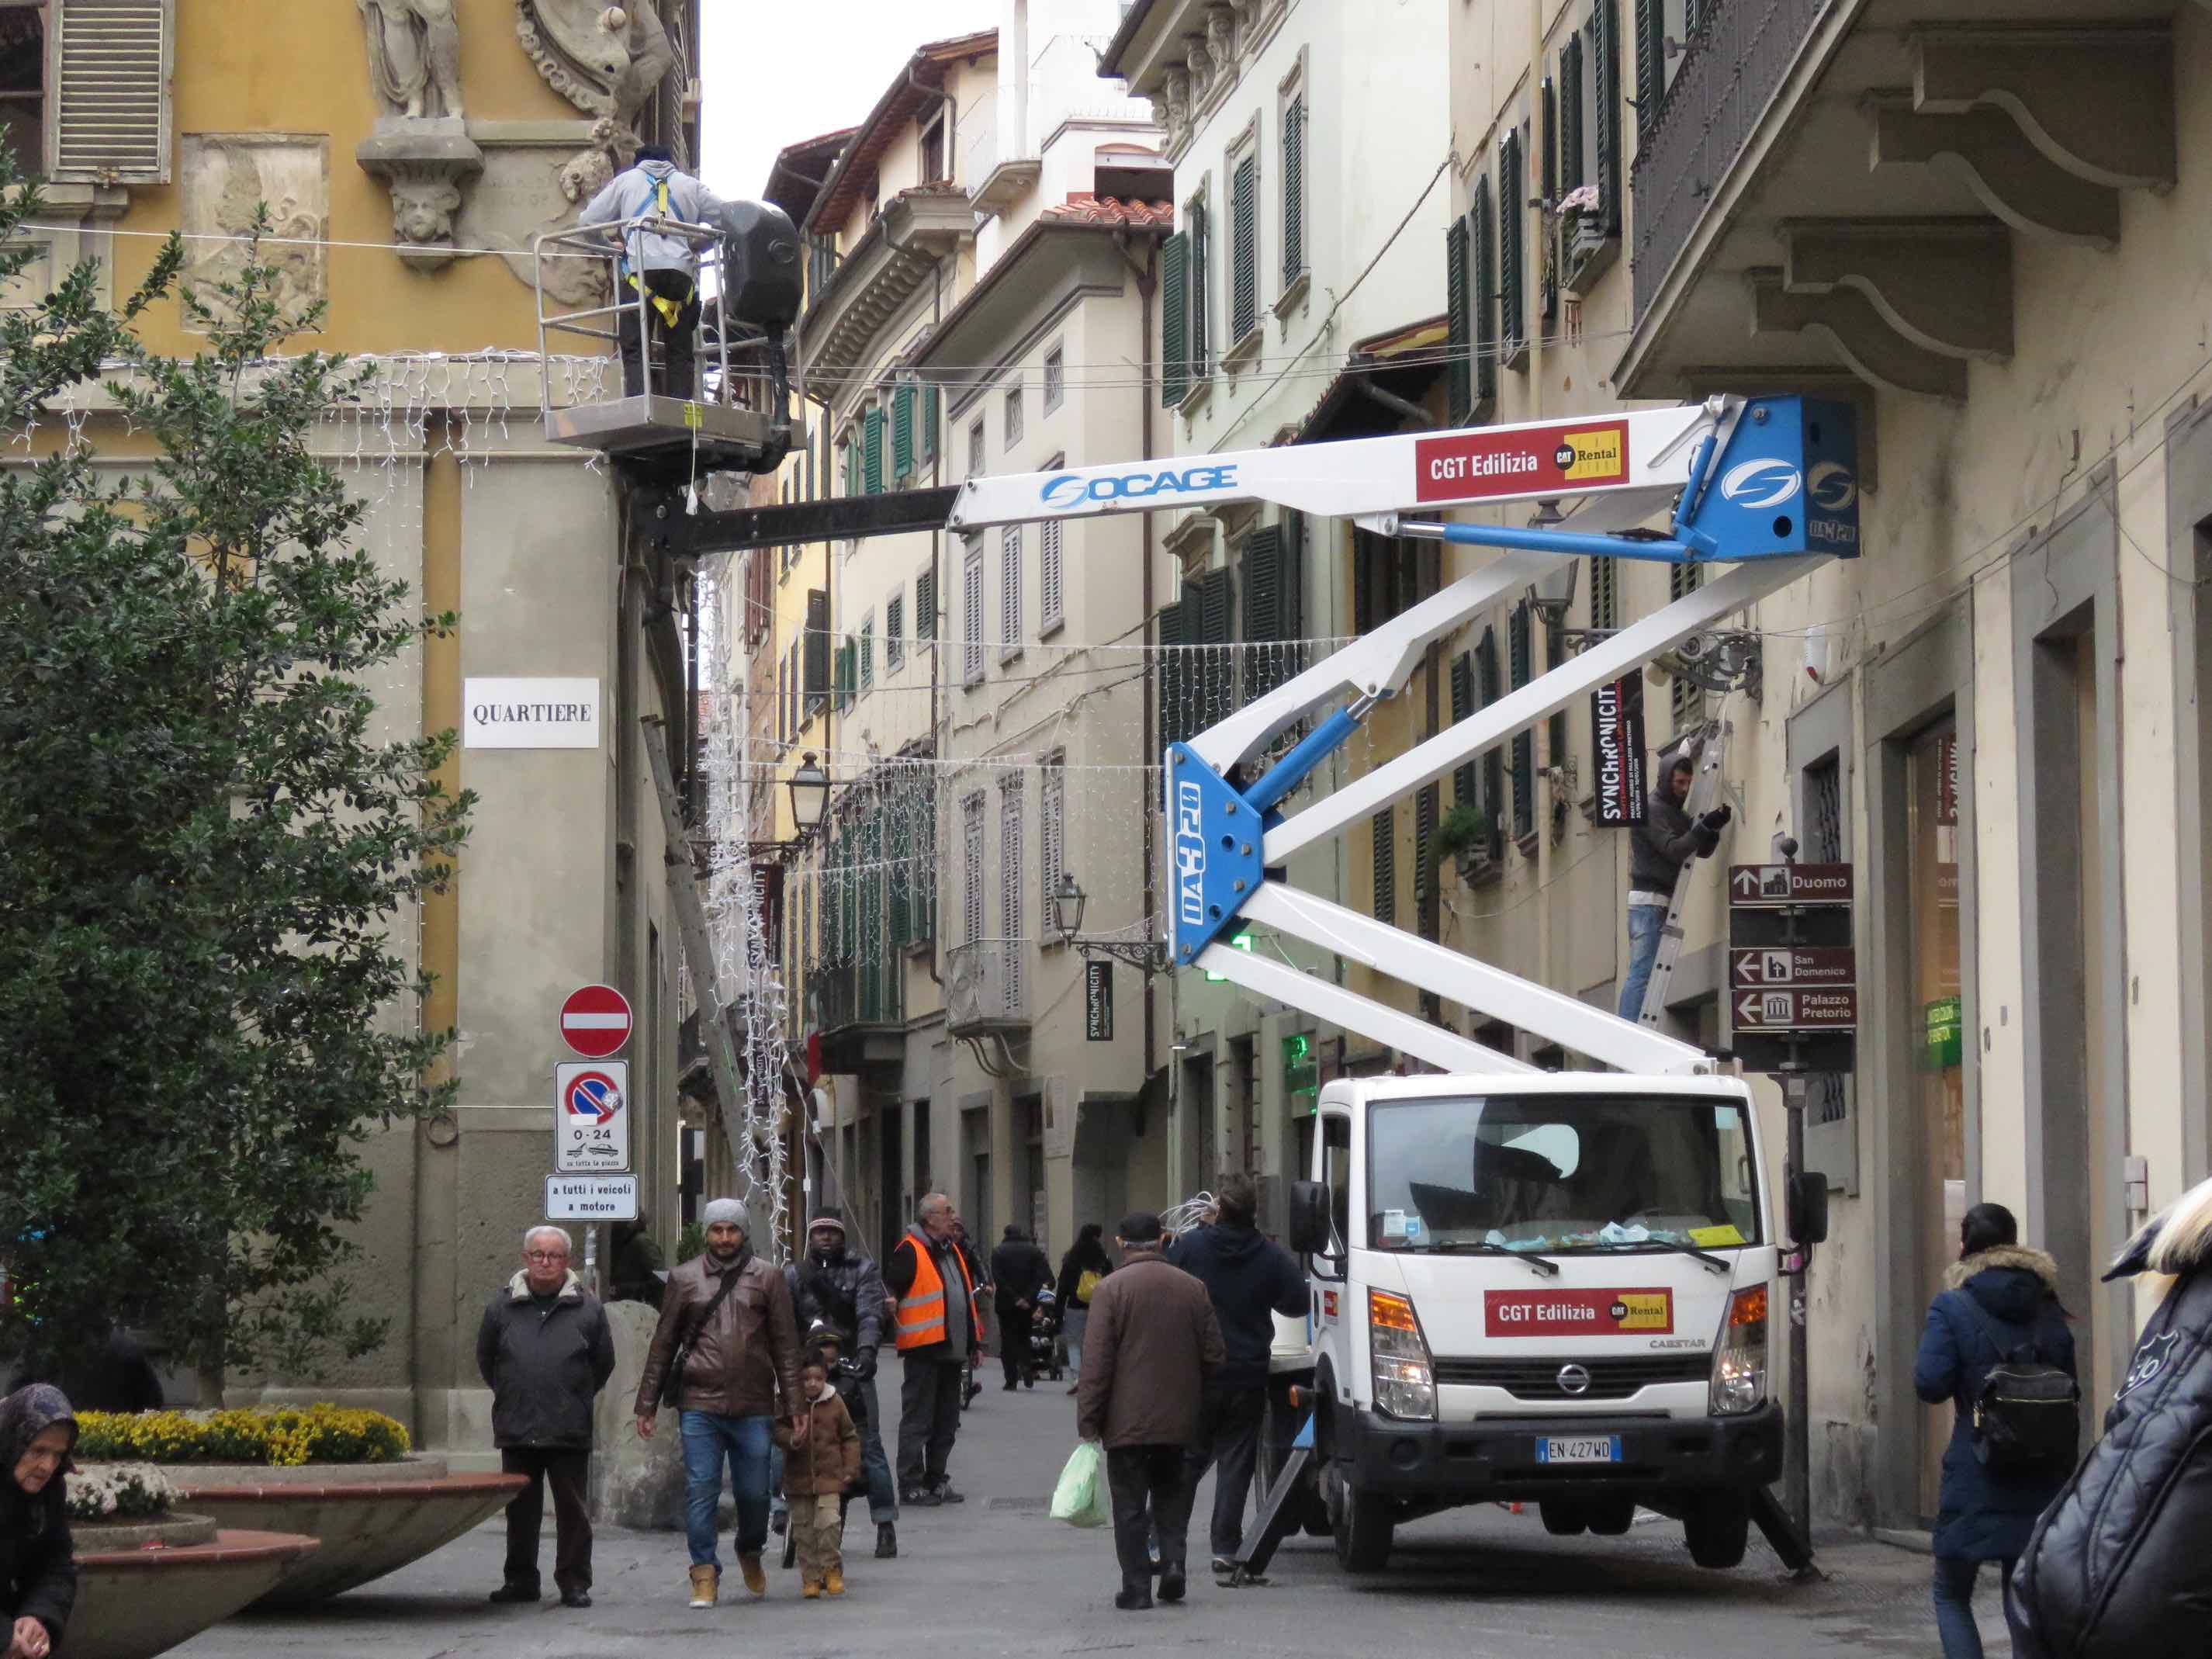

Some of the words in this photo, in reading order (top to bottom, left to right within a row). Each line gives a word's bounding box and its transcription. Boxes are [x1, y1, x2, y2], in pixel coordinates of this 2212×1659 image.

[1556, 450, 1573, 464] CAT
[1577, 447, 1617, 462] Rental
[1431, 455, 1467, 480] CGT
[1472, 451, 1538, 477] Edilizia
[473, 704, 591, 725] QUARTIERE
[1598, 688, 1621, 819] SYNCHRONICIT
[1792, 876, 1847, 888] Duomo
[1794, 955, 1814, 965] San
[1795, 968, 1846, 976] Domenico
[1802, 995, 1849, 1005] Palazzo
[1802, 1008, 1851, 1018] Pretorio
[553, 1186, 559, 1194] a
[563, 1184, 587, 1195] tutti
[597, 1183, 631, 1194] veicoli
[580, 1202, 615, 1211] motore
[1499, 1304, 1532, 1321] CGT
[1536, 1303, 1596, 1321] Edilizia
[1611, 1306, 1625, 1315] CAT
[1630, 1307, 1663, 1316] Rental
[1649, 1339, 1706, 1349] CABSTAR
[1549, 1443, 1564, 1458] EN
[1570, 1441, 1609, 1458] 427WD
